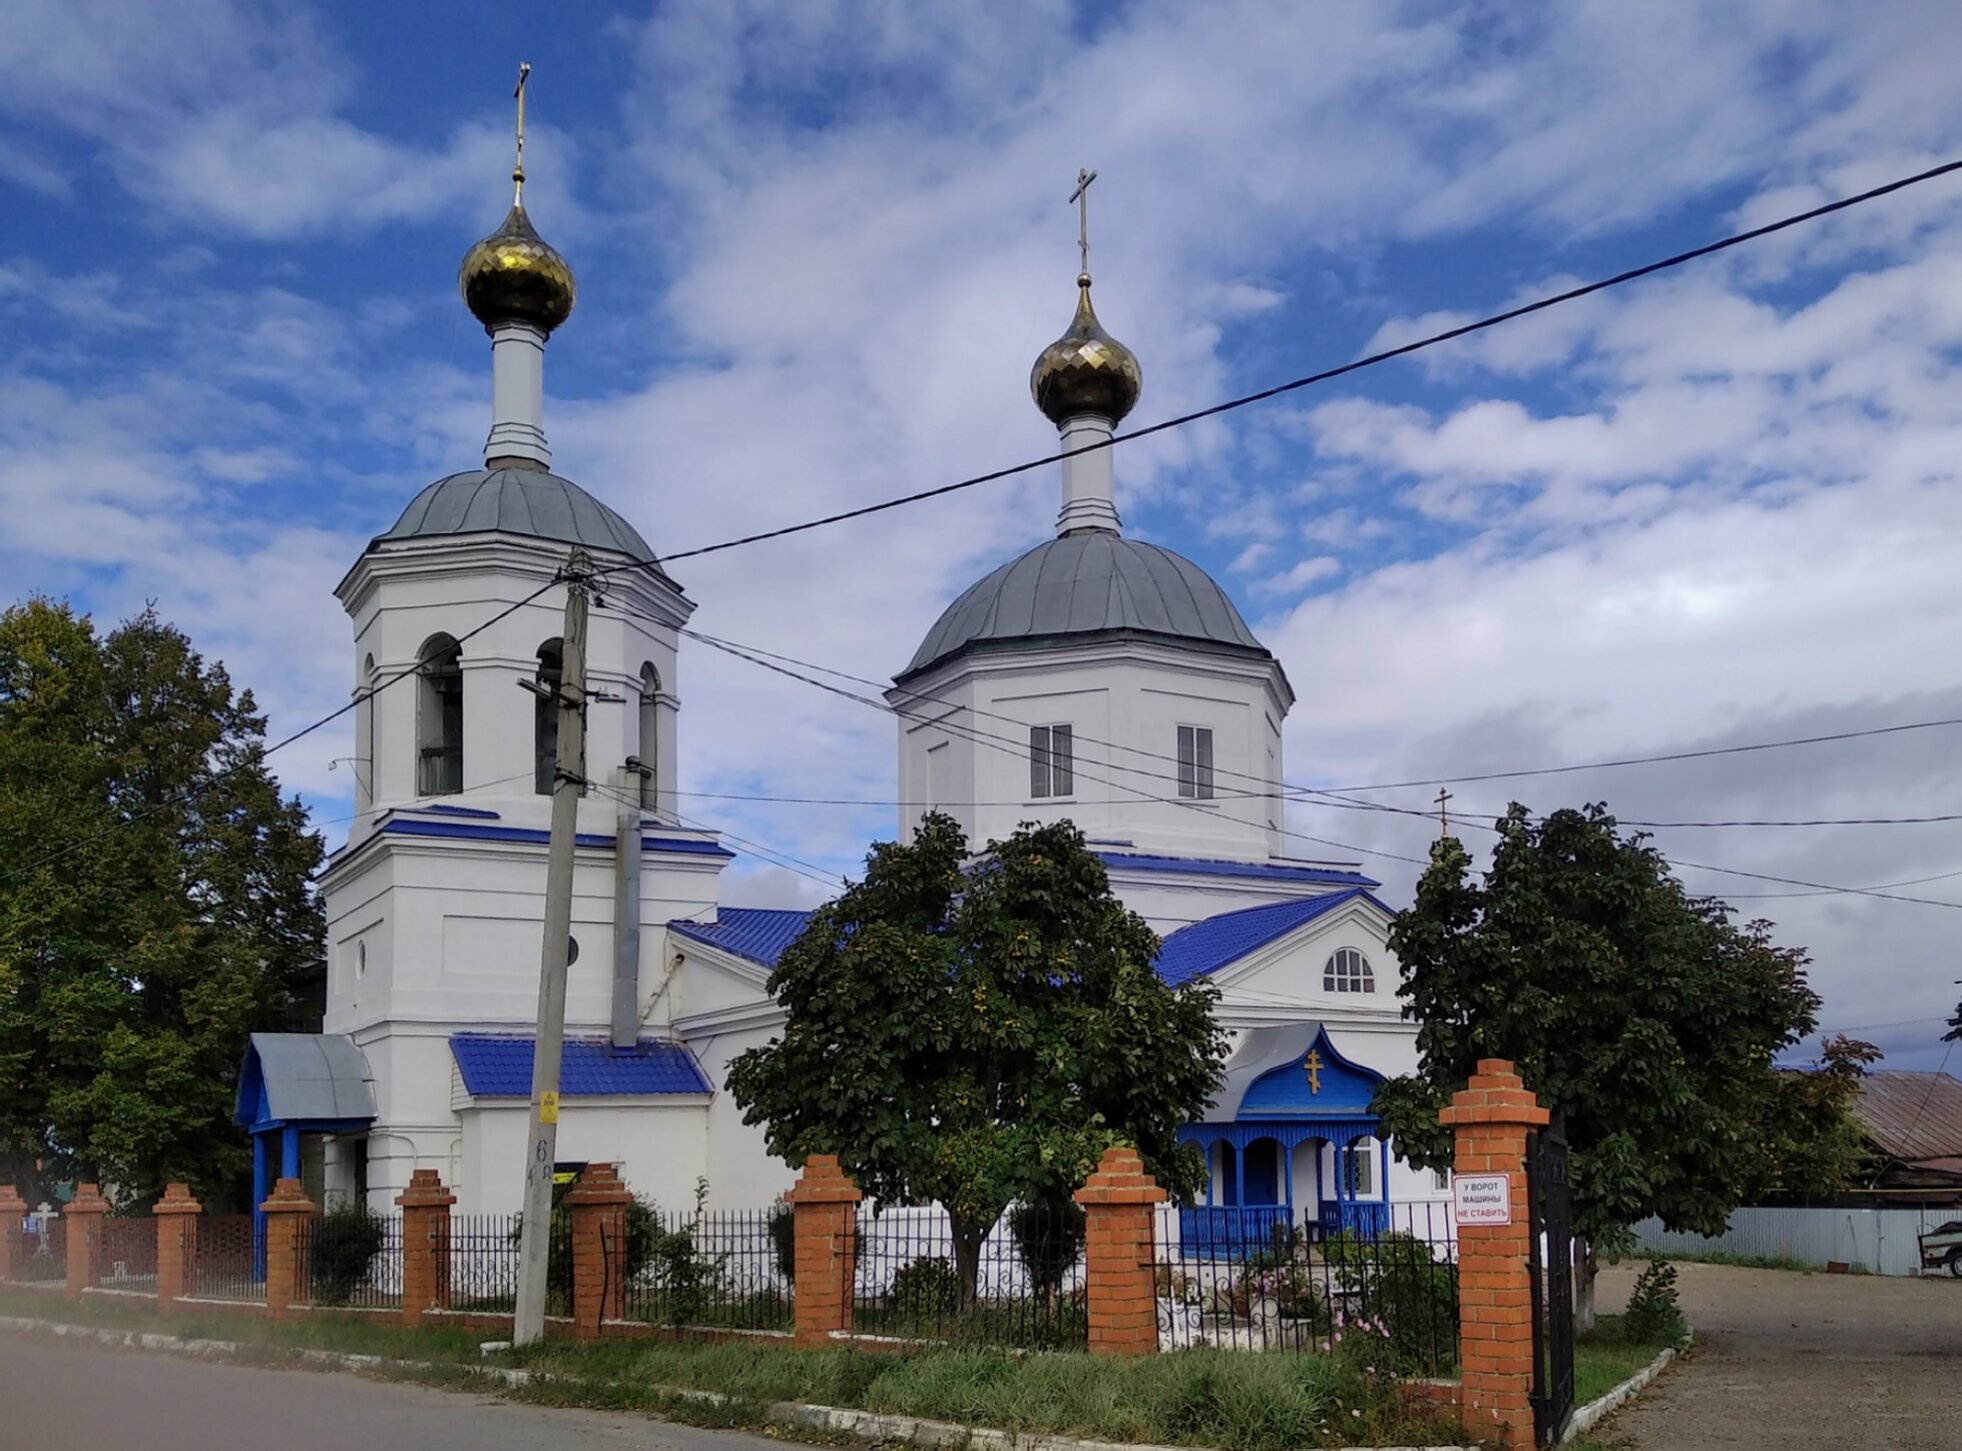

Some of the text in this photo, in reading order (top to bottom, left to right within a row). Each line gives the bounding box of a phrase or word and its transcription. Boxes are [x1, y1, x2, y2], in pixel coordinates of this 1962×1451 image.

[536, 1139, 547, 1162] 6
[1464, 1182, 1498, 1191] У ВОРОТ
[1462, 1195, 1501, 1203] МАШИНЫ
[1457, 1208, 1507, 1217] НЕ СТАВИТЬ
